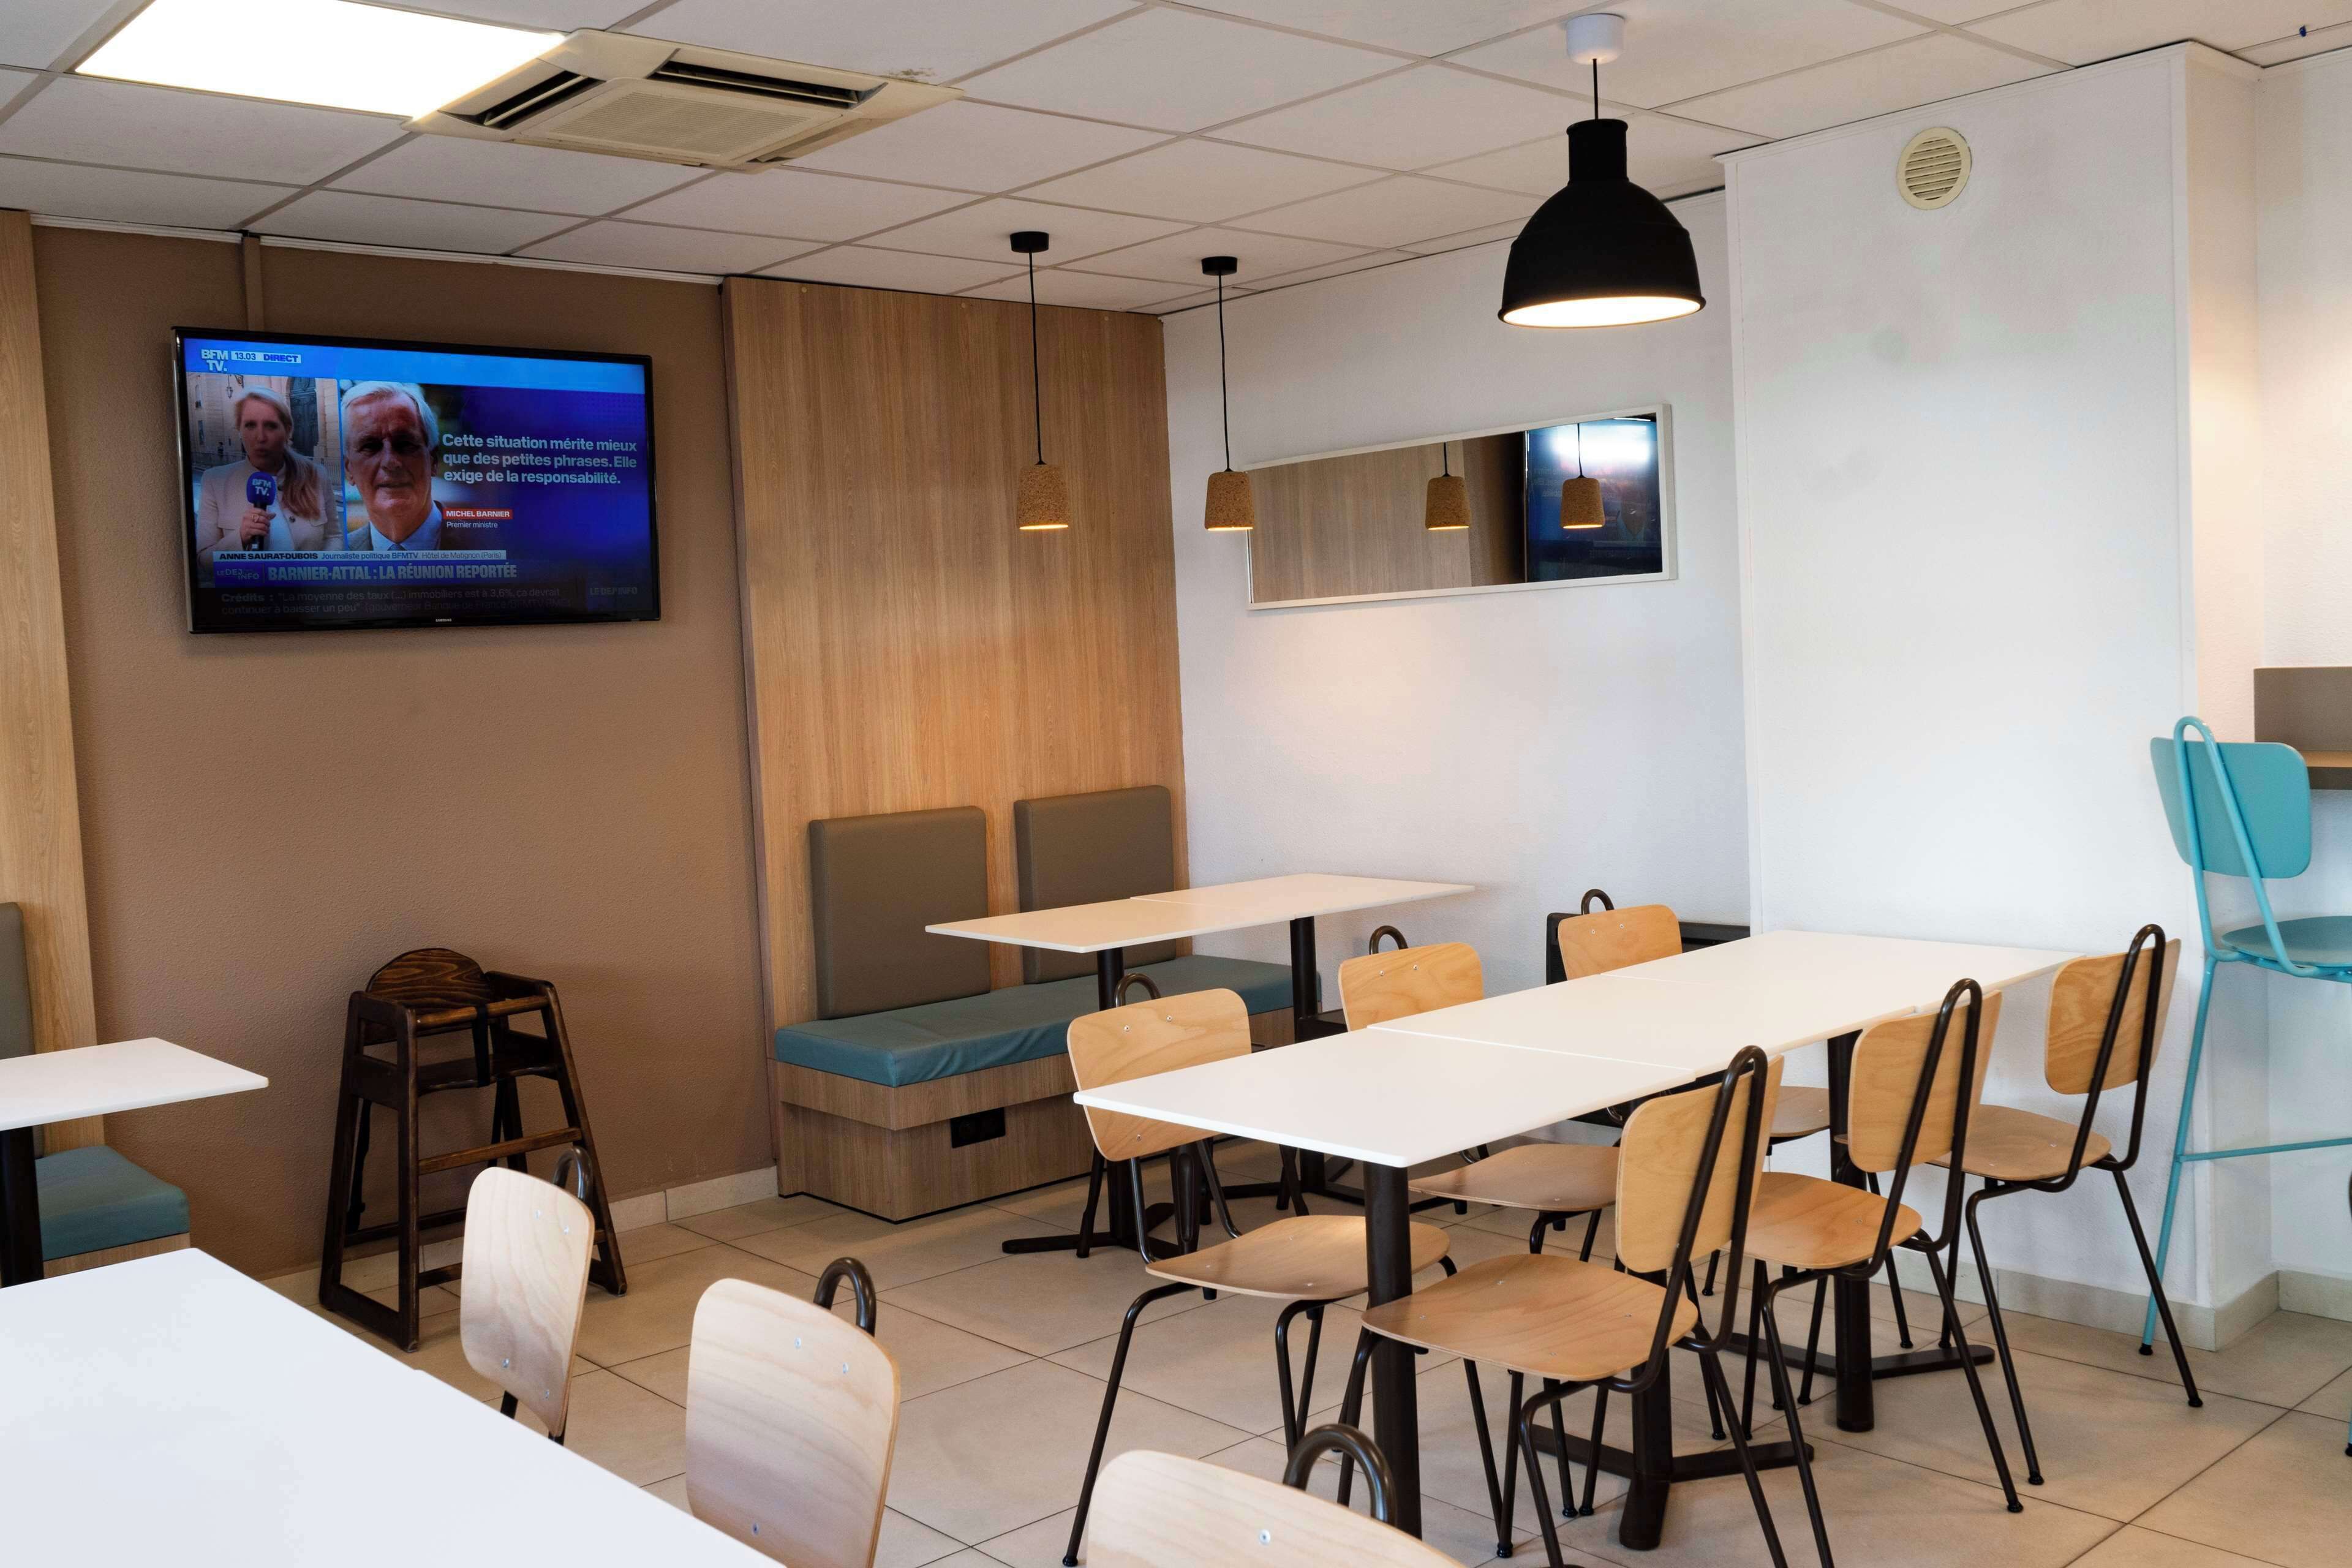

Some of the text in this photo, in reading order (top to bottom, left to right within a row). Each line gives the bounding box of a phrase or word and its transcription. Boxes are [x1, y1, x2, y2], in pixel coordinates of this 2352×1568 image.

[201, 349, 228, 360] BFM
[206, 360, 227, 371] TV.
[442, 434, 637, 451] Cette situation mérite mieux
[443, 452, 637, 469] que des petites phrases. Elle
[252, 479, 271, 488] BFM
[444, 470, 620, 485] exige de la responsabilité.
[268, 567, 371, 581] BARNIER-ATTAL
[379, 566, 396, 579] LA
[398, 563, 454, 579] RÉUNION
[456, 562, 518, 579] REPORTÉE
[297, 593, 344, 603] moyenne
[347, 590, 364, 600] des
[408, 589, 462, 599] immobiliers
[529, 587, 560, 597] devrait
[283, 604, 319, 614] baisser
[323, 604, 336, 612] un
